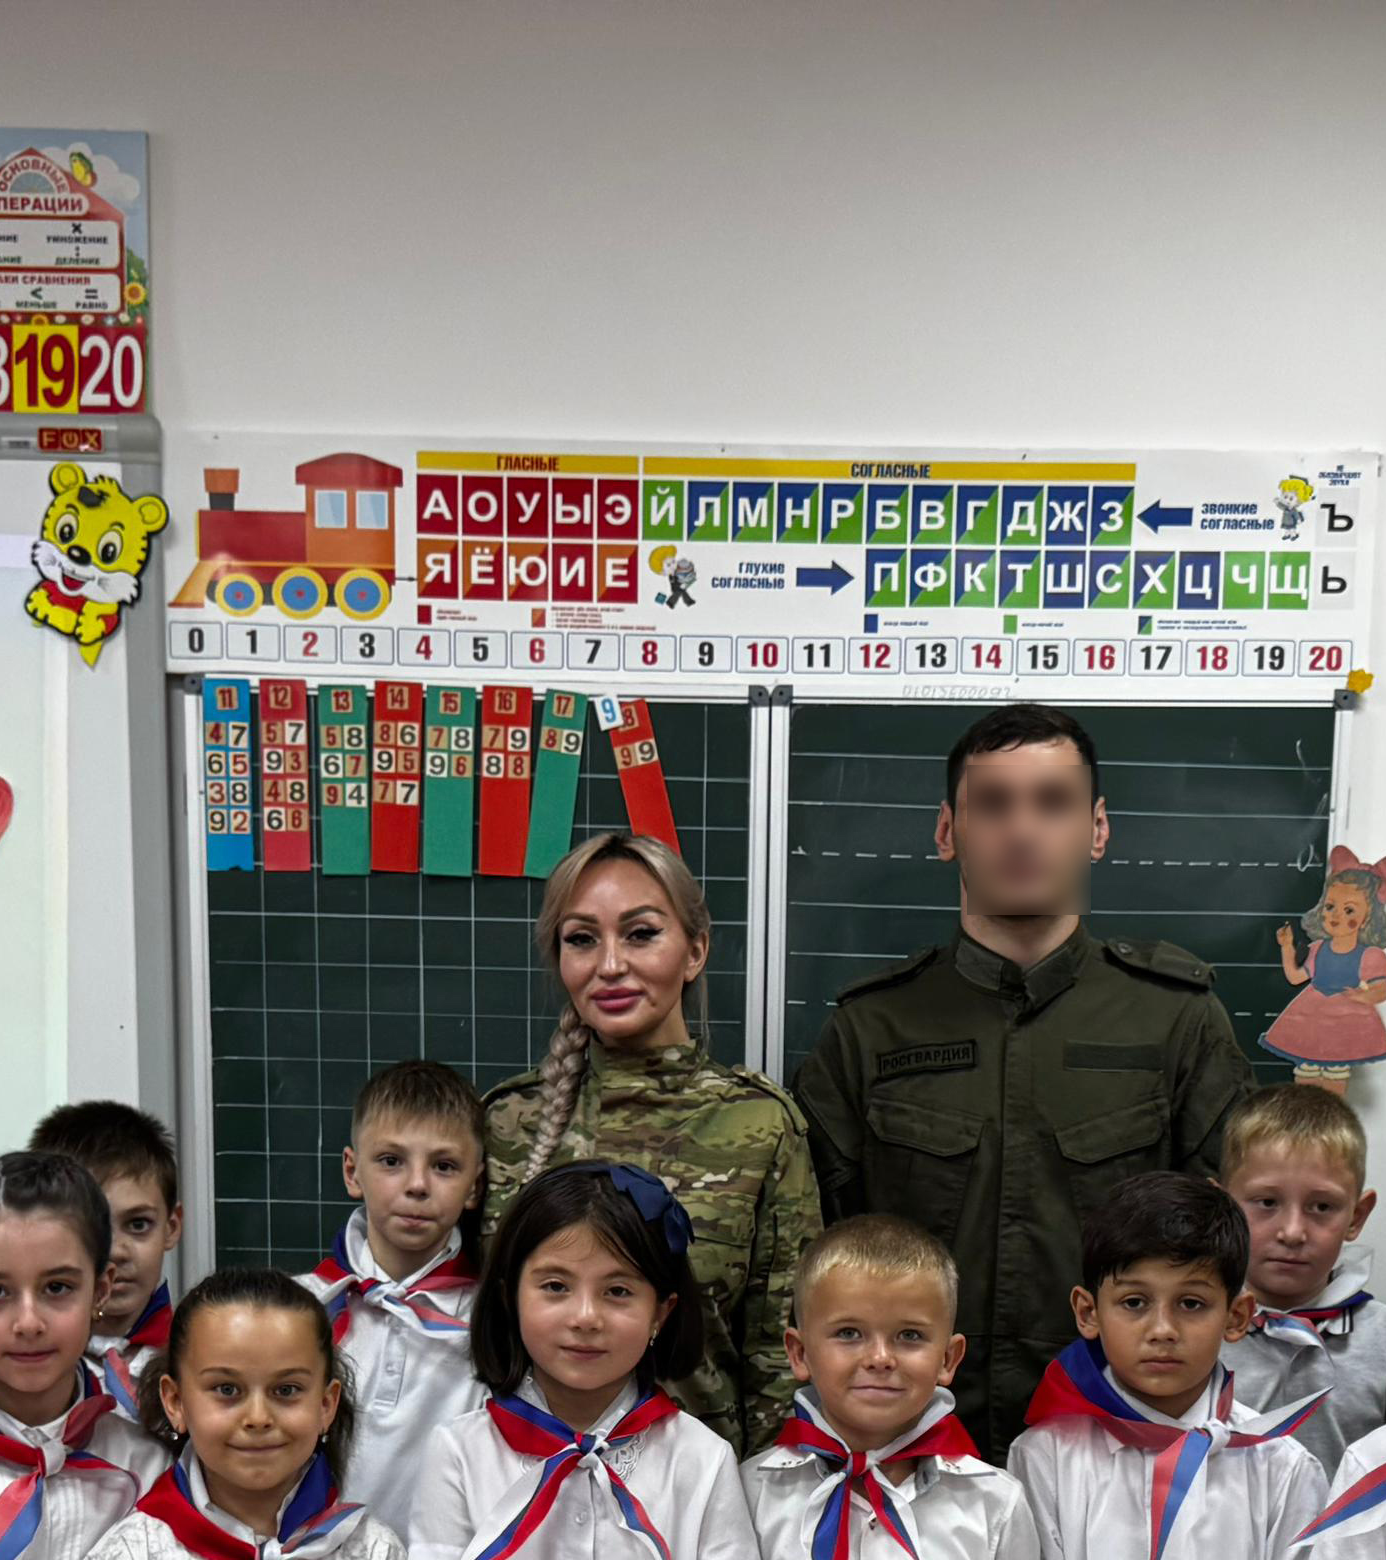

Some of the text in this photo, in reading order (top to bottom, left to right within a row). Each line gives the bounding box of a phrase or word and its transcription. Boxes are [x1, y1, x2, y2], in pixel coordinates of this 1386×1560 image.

[46, 235, 108, 244] УМНОЖЕНИЕ
[55, 257, 101, 266] ДЕЛЕНИЕ
[22, 275, 91, 286] СРАВНЕНИЯ
[75, 302, 108, 310] РАВНО
[14, 332, 75, 410] 19
[79, 334, 143, 409] 20
[42, 430, 99, 448] FOX
[496, 455, 560, 472] ГЛАСНЫЕ
[850, 462, 931, 479] СОГЛАСНЫЕ
[188, 627, 1343, 671] 0 1 2 3 4 5 6 7 8 9 10 11 12 13 14 15 16 17 18 19 20
[218, 687, 235, 706] 11
[271, 687, 288, 706] 12
[333, 692, 350, 711] 13
[388, 689, 406, 708] 14
[442, 693, 459, 712] 15
[496, 692, 514, 712] 16
[555, 696, 572, 715] 17
[882, 1046, 973, 1071] РОСГВАРДИЯ
